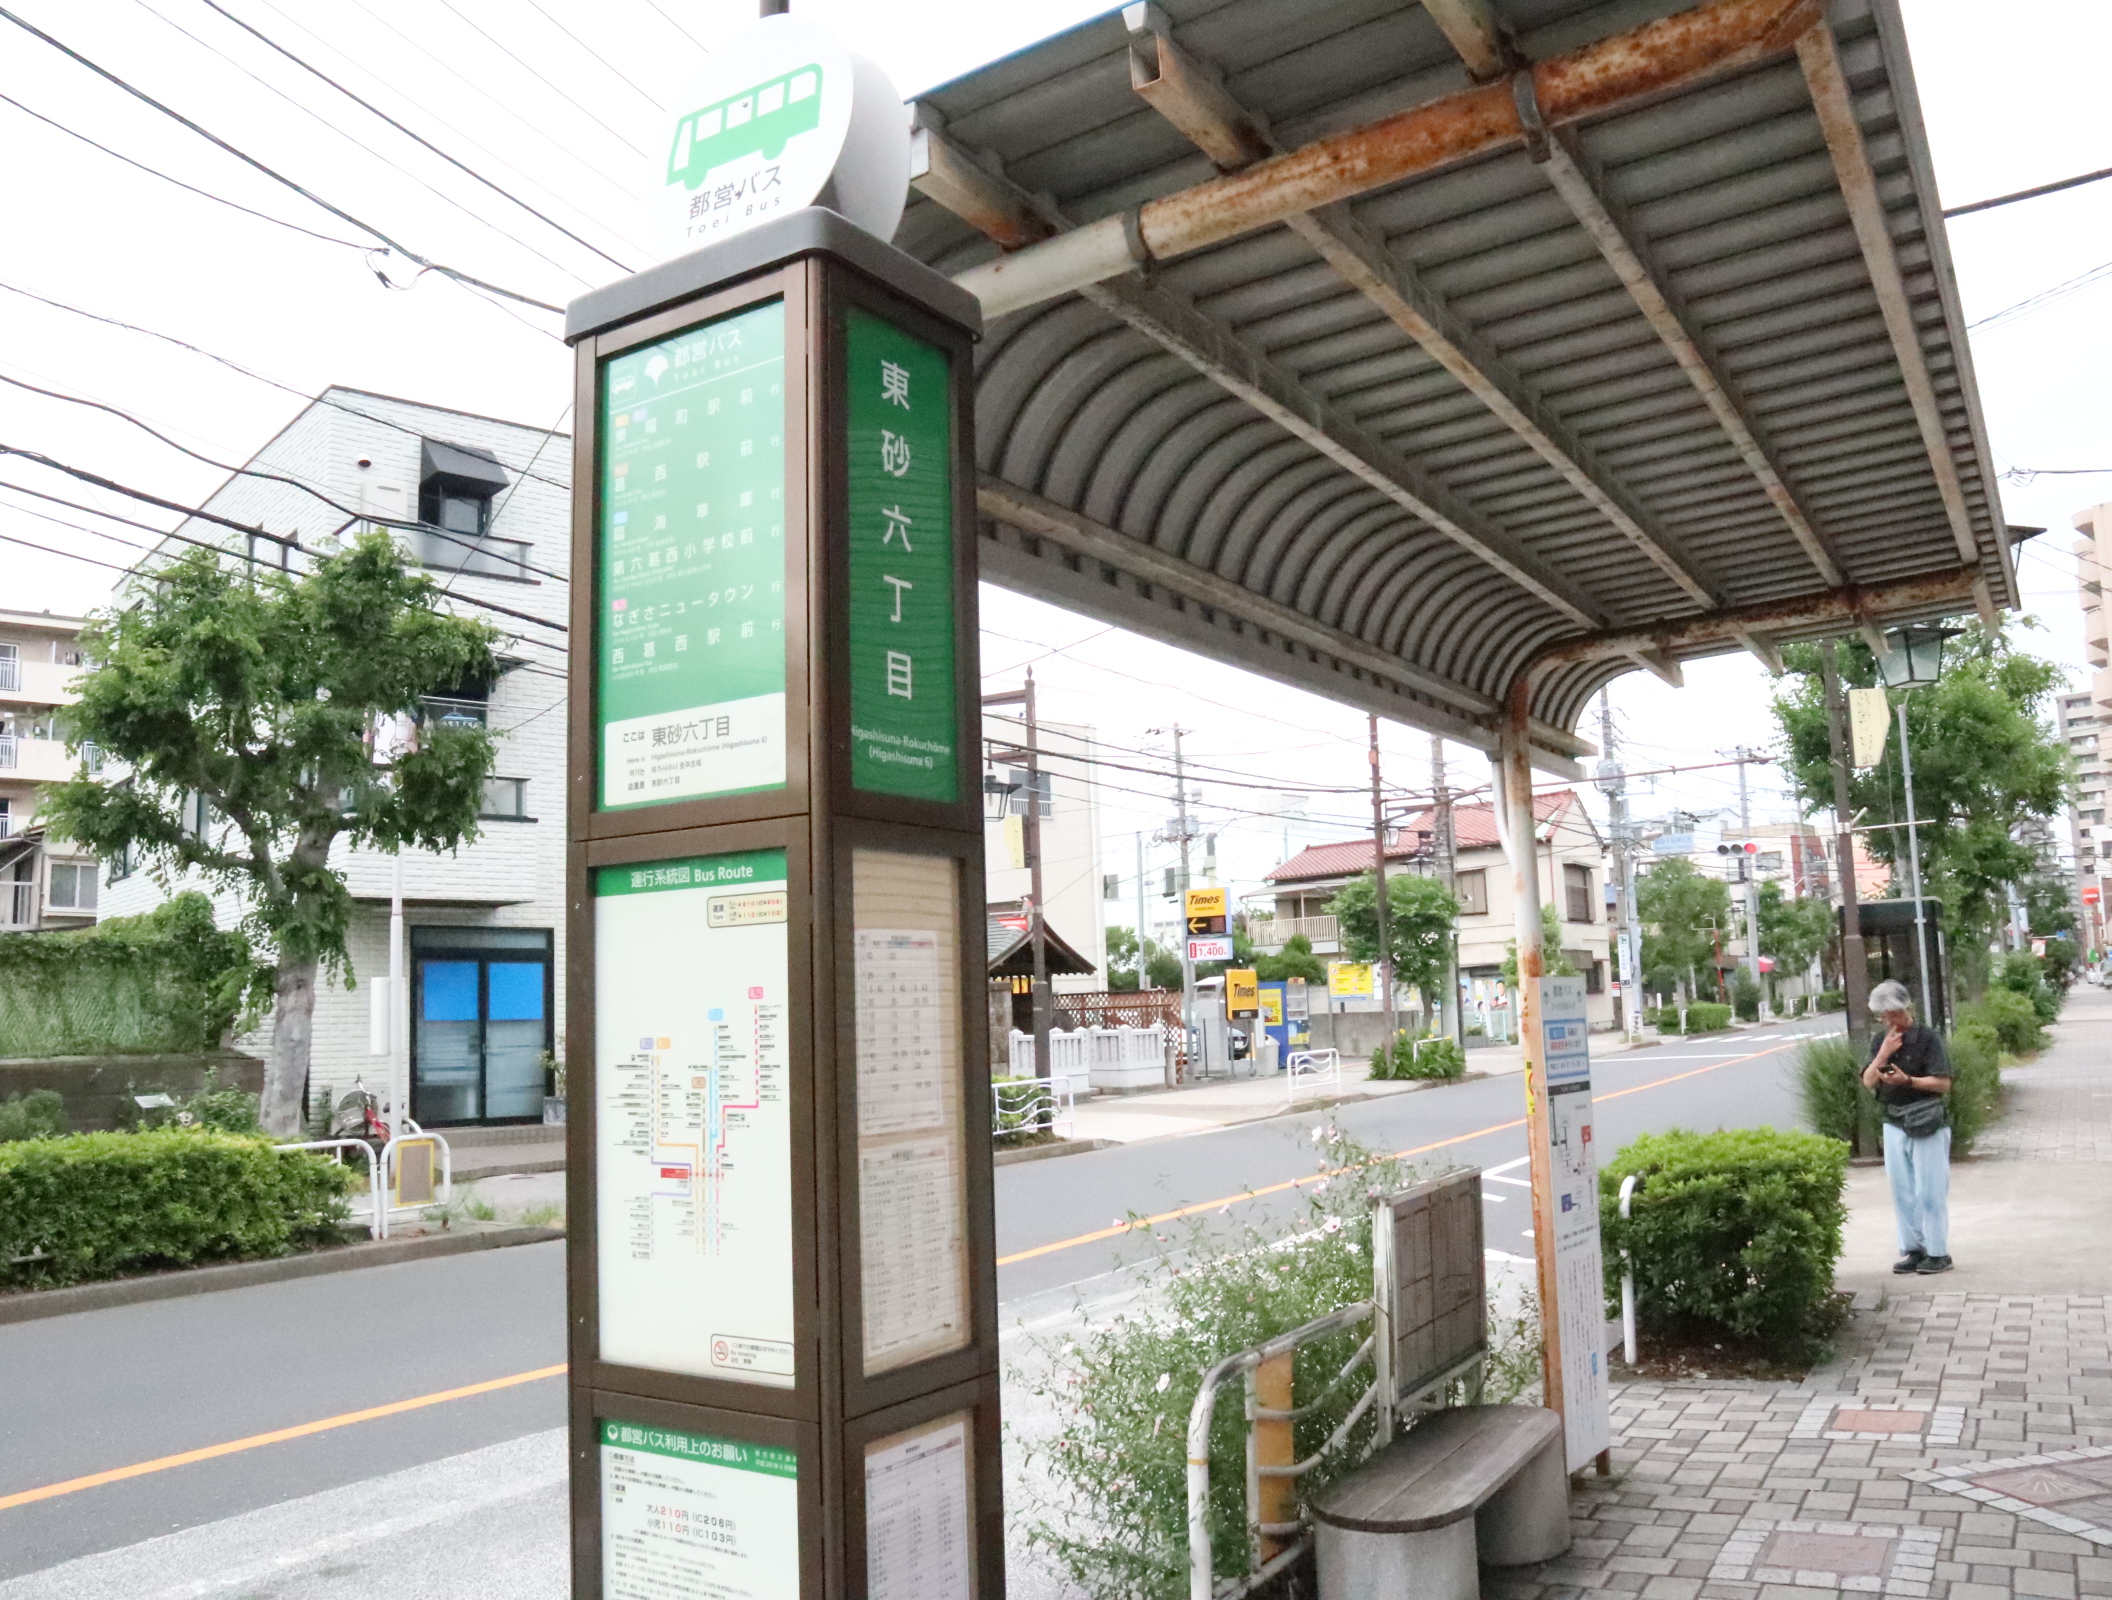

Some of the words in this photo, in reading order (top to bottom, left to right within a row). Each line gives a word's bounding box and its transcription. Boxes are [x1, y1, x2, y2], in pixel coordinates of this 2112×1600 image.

[689, 166, 782, 220] 都営バス
[686, 215, 730, 238] Toei
[745, 197, 781, 217] Bus
[674, 328, 743, 368] 都営バス
[674, 368, 705, 382] Toei
[714, 357, 740, 369] Bus
[880, 359, 913, 700] 東砂六丁目
[613, 584, 753, 628] なぎさニュータウン
[771, 581, 781, 593] 行
[771, 619, 781, 631] 行
[623, 731, 645, 743] ここは
[651, 715, 730, 748] 東砂六丁目
[869, 745, 923, 767] (Higashisuna
[924, 756, 933, 769] 6)
[630, 867, 690, 888] 運行系統図
[694, 868, 715, 883] Bus
[717, 865, 753, 880] Route
[1190, 895, 1220, 906] Times
[1233, 983, 1255, 998] Times
[620, 1426, 748, 1462] 都営バス利用上のお願い
[647, 1504, 689, 1521] 大人210円
